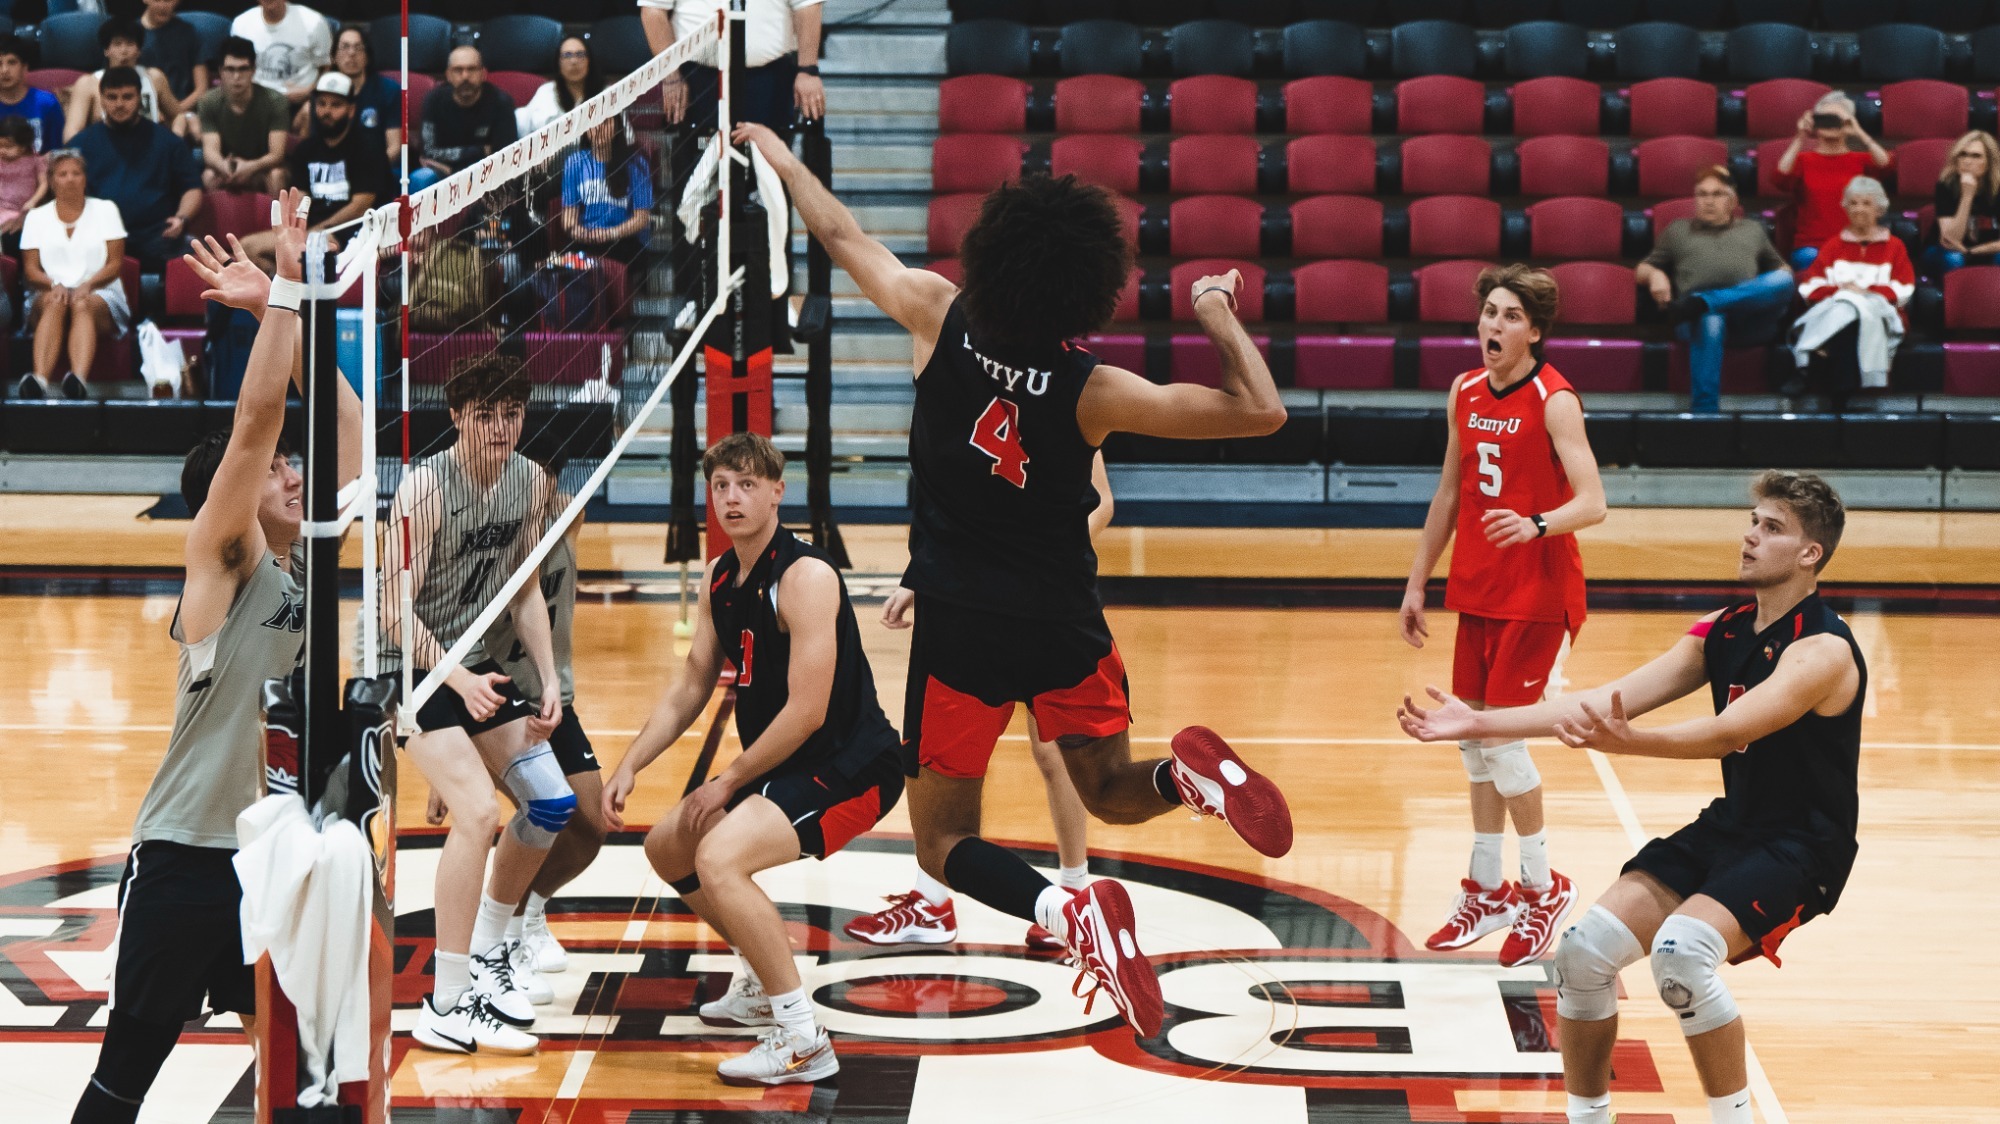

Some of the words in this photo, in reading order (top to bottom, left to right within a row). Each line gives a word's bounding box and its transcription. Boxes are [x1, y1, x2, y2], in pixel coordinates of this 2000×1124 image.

[963, 332, 1052, 396] rryU
[969, 396, 1030, 489] 4
[1477, 442, 1503, 498] 5
[459, 557, 497, 605] 11
